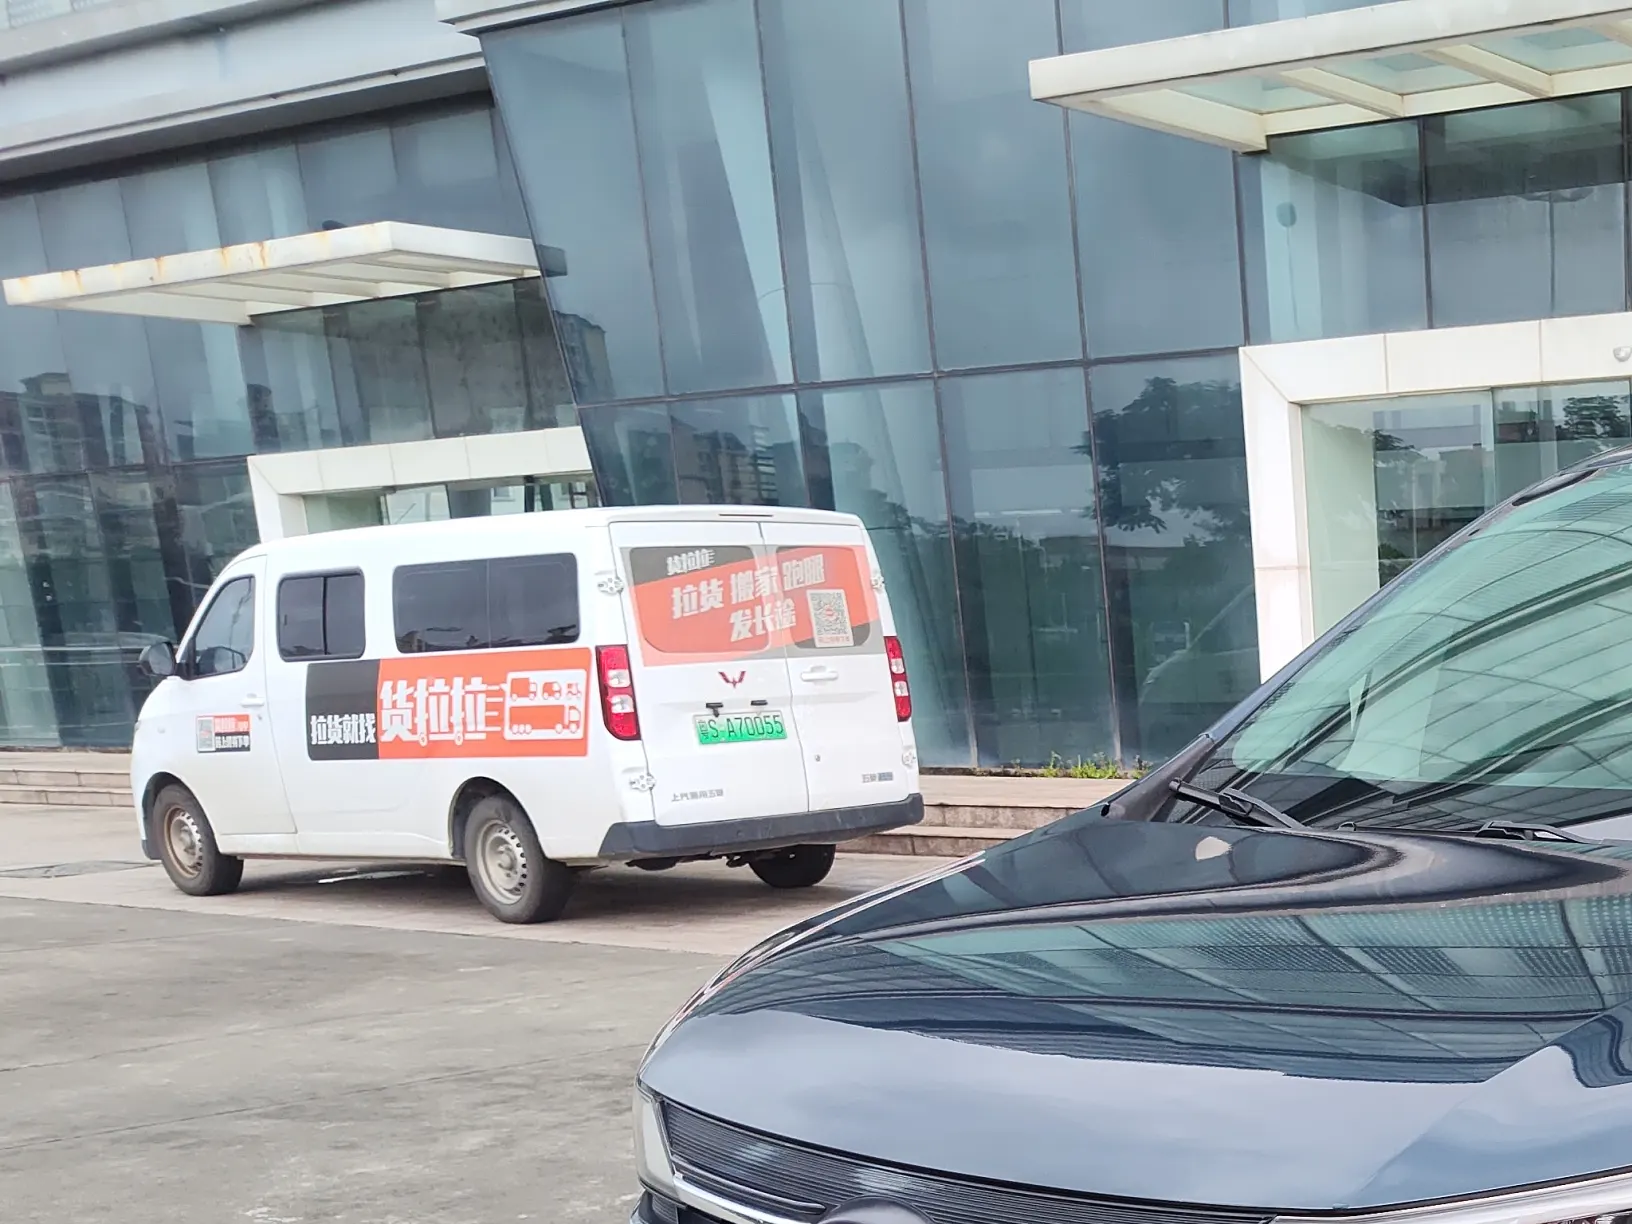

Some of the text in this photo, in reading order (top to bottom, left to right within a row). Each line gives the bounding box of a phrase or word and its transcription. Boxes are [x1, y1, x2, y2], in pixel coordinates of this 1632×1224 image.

[667, 548, 715, 575] 货拉拉
[672, 554, 825, 619] 拉货 搬家 跑腿
[729, 598, 796, 642] 发长途
[310, 677, 492, 746] 拉货就找 货拉拉
